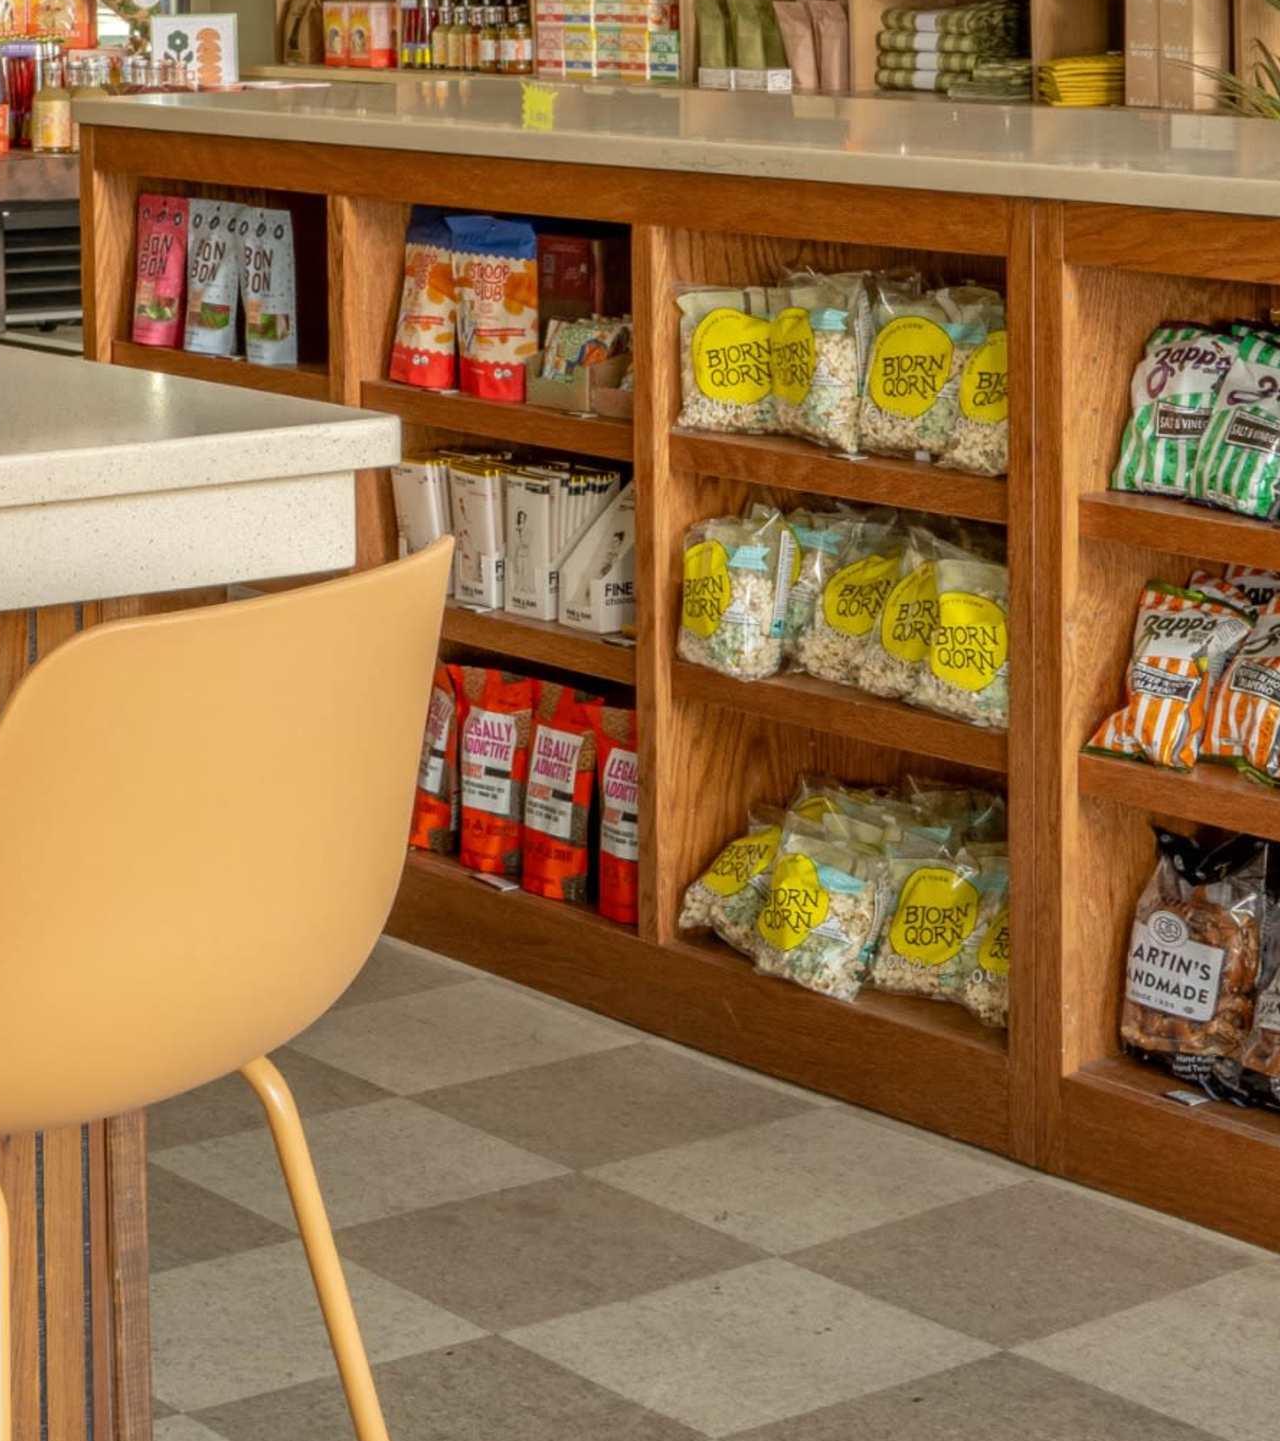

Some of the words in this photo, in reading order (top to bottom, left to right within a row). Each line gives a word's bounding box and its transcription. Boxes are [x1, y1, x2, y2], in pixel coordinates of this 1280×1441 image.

[140, 254, 168, 277] BON
[244, 246, 273, 269] BON
[192, 259, 218, 283] BON
[244, 269, 271, 294] BON
[706, 338, 771, 369] BJORN
[882, 354, 946, 377] BJORN
[710, 362, 771, 387] QORN
[882, 374, 938, 399] QORN
[605, 582, 633, 599] FINE
[937, 625, 999, 651] BJORN
[938, 649, 998, 676] QORN
[769, 888, 820, 909] JORN
[904, 904, 970, 928] BJORN
[904, 926, 965, 947] QORN
[1133, 944, 1212, 983] ARTIN'S
[1127, 967, 1210, 1005] ANDMADE
